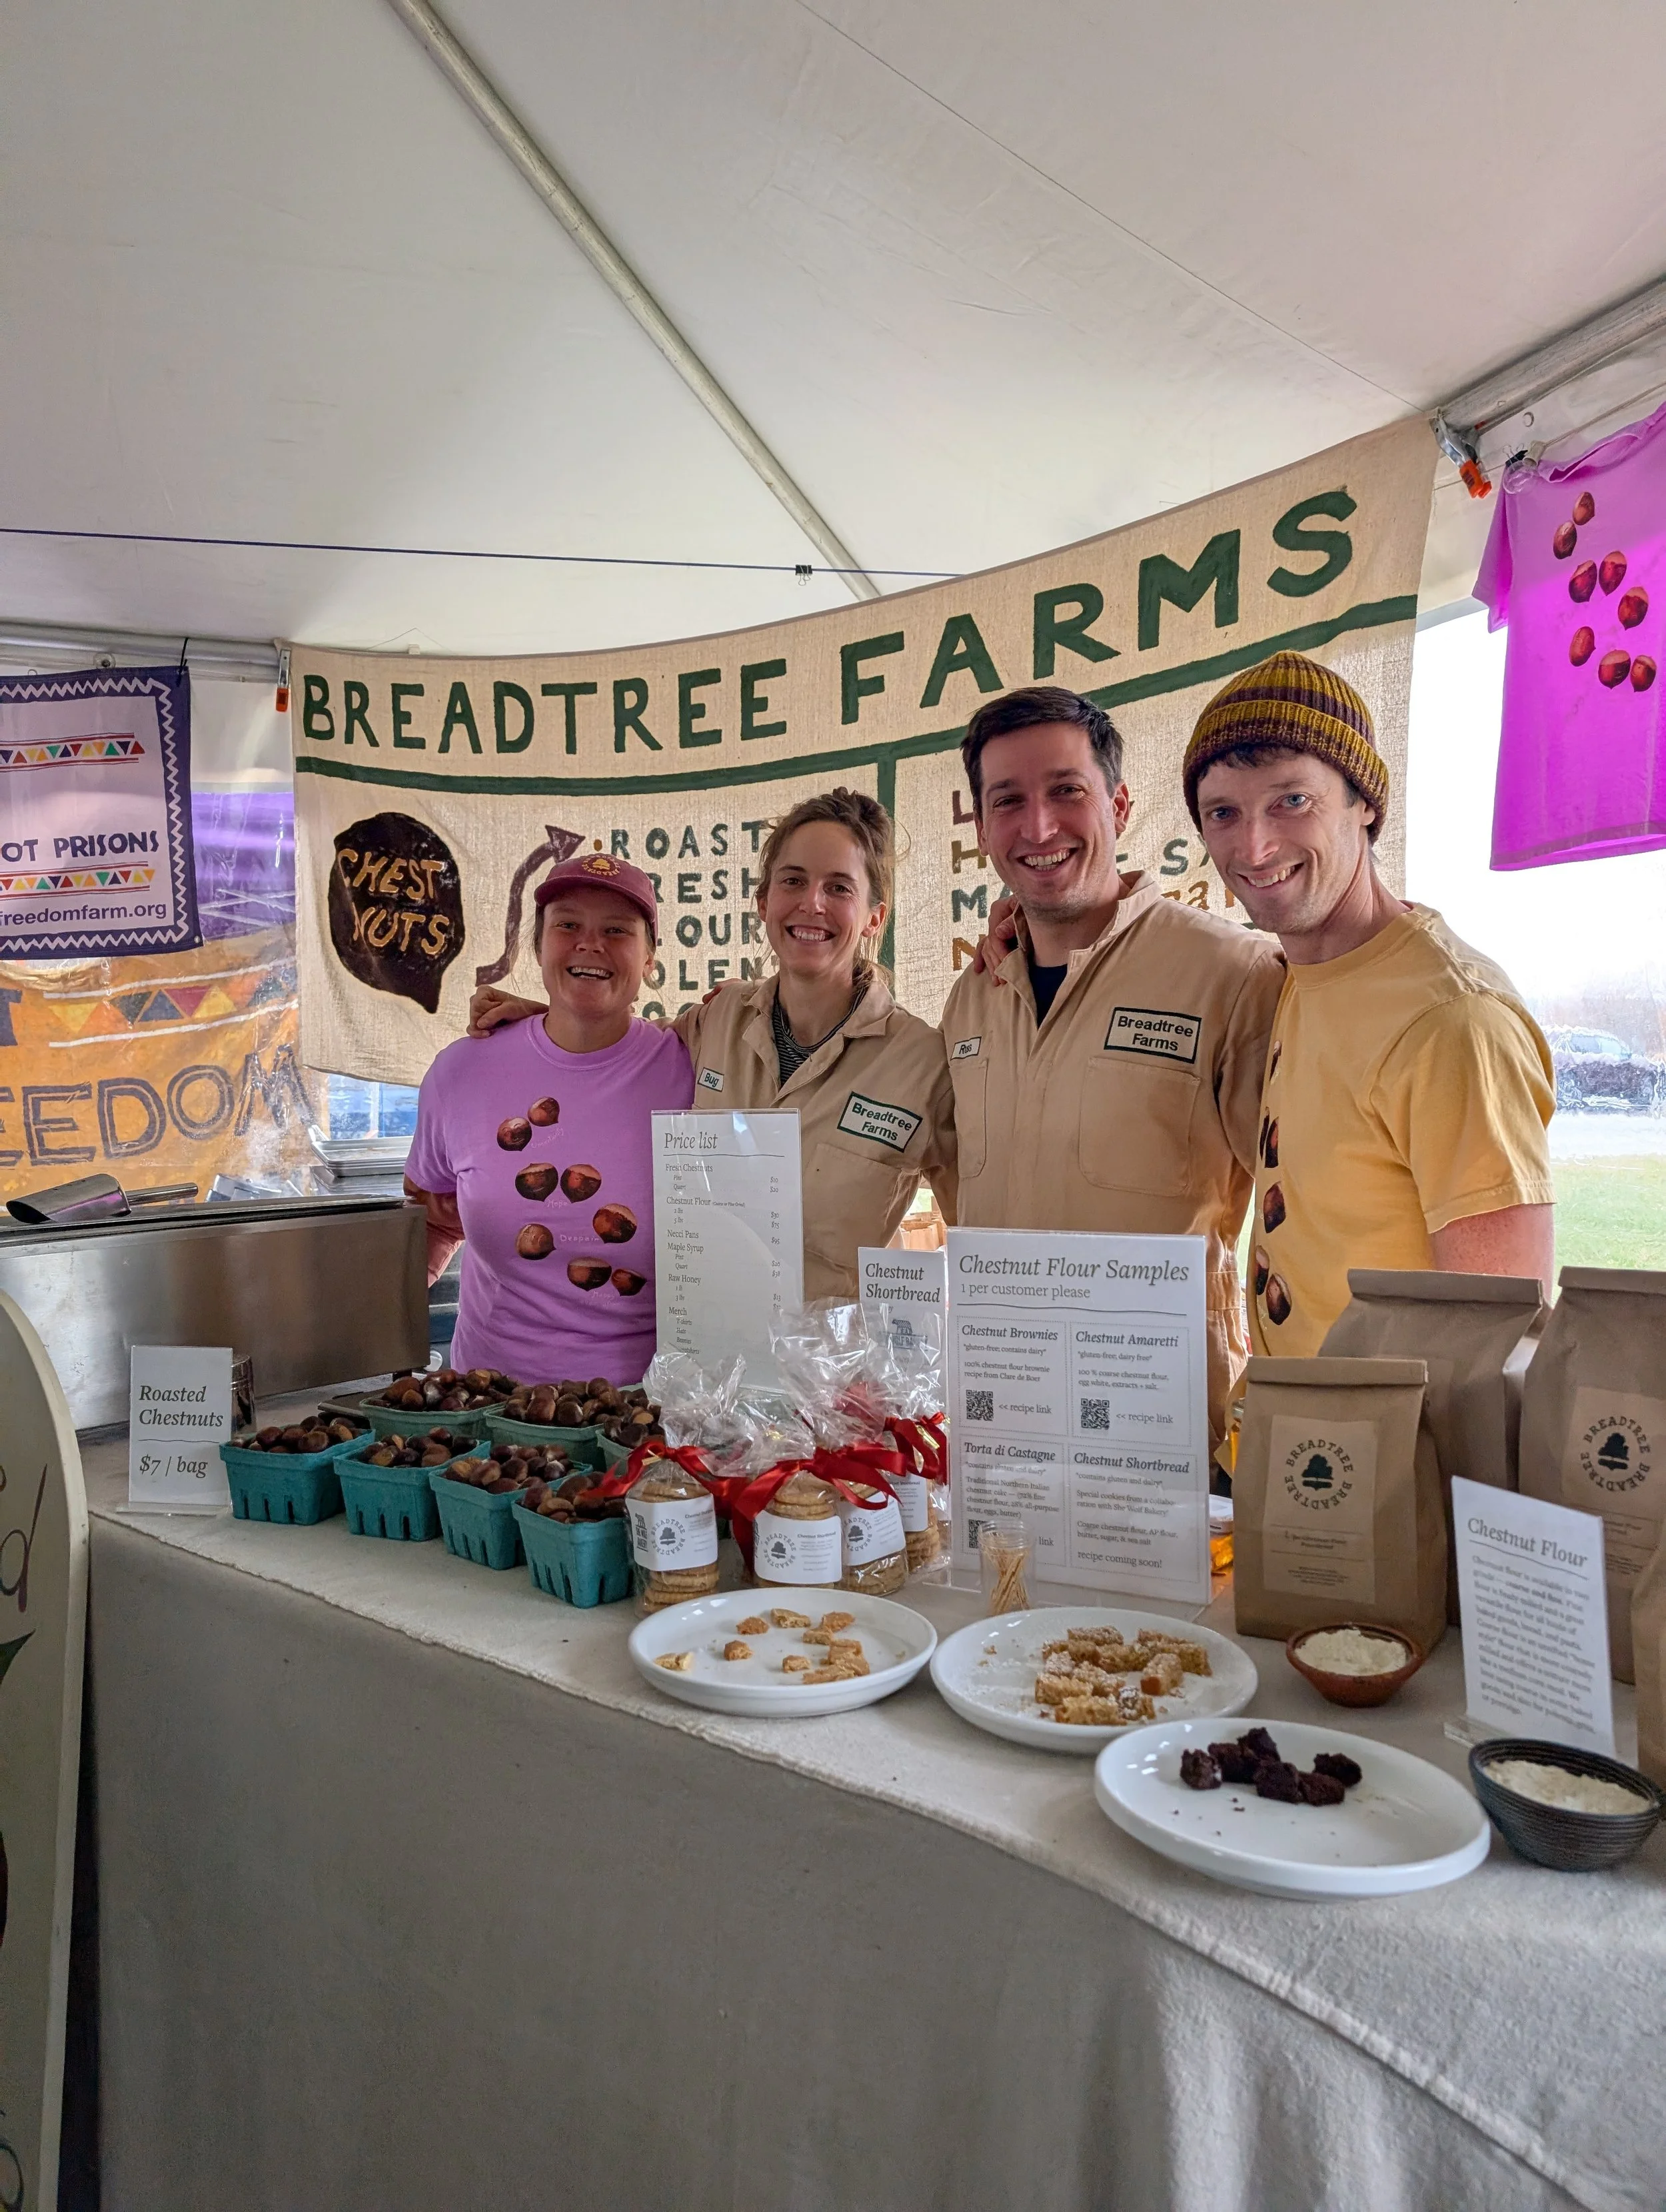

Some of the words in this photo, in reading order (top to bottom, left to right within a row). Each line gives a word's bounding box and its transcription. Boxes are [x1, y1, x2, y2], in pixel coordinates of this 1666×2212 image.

[303, 658, 788, 755] BREADTREE
[840, 487, 1357, 726] FARMS
[0, 838, 38, 862] OT
[53, 830, 159, 858] PRISONS
[338, 848, 445, 899] CHEST
[353, 907, 450, 955] NUTS
[1118, 1015, 1194, 1037] Breadtree
[1132, 1033, 1179, 1051] Farms
[704, 1073, 719, 1087] Bug
[852, 1101, 912, 1131] Breadtree
[664, 1132, 696, 1149] Price
[699, 1131, 718, 1149] list
[862, 1122, 898, 1141] Farms
[666, 1163, 682, 1172] Fresh
[683, 1163, 713, 1172] Chestnuts
[666, 1197, 693, 1205] Chestnut
[694, 1197, 711, 1206] Flour
[667, 1229, 684, 1238] Necci
[667, 1243, 685, 1252] Maple
[686, 1243, 704, 1254] Syrup
[866, 1263, 924, 1281] Chestnut
[959, 1255, 1041, 1275] Chestnut
[1046, 1257, 1101, 1277] Flour
[1106, 1259, 1190, 1286] Samples
[668, 1273, 680, 1282] Raw
[682, 1275, 701, 1286] Honey
[866, 1283, 940, 1303] Shortbread
[962, 1283, 966, 1293] 1
[969, 1283, 988, 1297] per
[992, 1284, 1049, 1297] customer
[1052, 1285, 1090, 1300] please
[668, 1307, 687, 1316] Merch
[962, 1325, 1008, 1337] Chestnut
[1010, 1327, 1058, 1340] Brownies
[1076, 1331, 1125, 1344] Chestnut
[1128, 1334, 1179, 1347] Amaretti
[981, 1361, 1007, 1370] chestnut
[139, 1385, 207, 1402] Roasted
[1010, 1403, 1034, 1414] recipe
[1036, 1404, 1052, 1414] link
[139, 1408, 224, 1427] Chestnuts
[1128, 1412, 1154, 1424] recipe
[1156, 1413, 1174, 1424] link
[1583, 1416, 1651, 1454] BREADTREE
[964, 1442, 992, 1454] Torta
[994, 1444, 1006, 1456] di
[1008, 1446, 1056, 1463] Castagne
[1285, 1439, 1353, 1472] BREADTREE
[139, 1454, 161, 1476] $7
[165, 1456, 172, 1476] /
[177, 1456, 209, 1478] bag
[1074, 1452, 1124, 1467] Chestnut
[1126, 1457, 1190, 1473] Shortbread
[966, 1476, 999, 1485] Traditional
[1000, 1479, 1029, 1488] Northern
[1107, 1475, 1128, 1484] gluten
[1077, 1490, 1099, 1499] Special
[1100, 1492, 1125, 1501] cookies
[1039, 1536, 1054, 1546] link
[1467, 1517, 1536, 1552] Chestnut
[1541, 1539, 1588, 1567] Flour
[1078, 1551, 1104, 1562] recipe
[1105, 1554, 1136, 1567] coming
[1138, 1558, 1162, 1568] soon!
